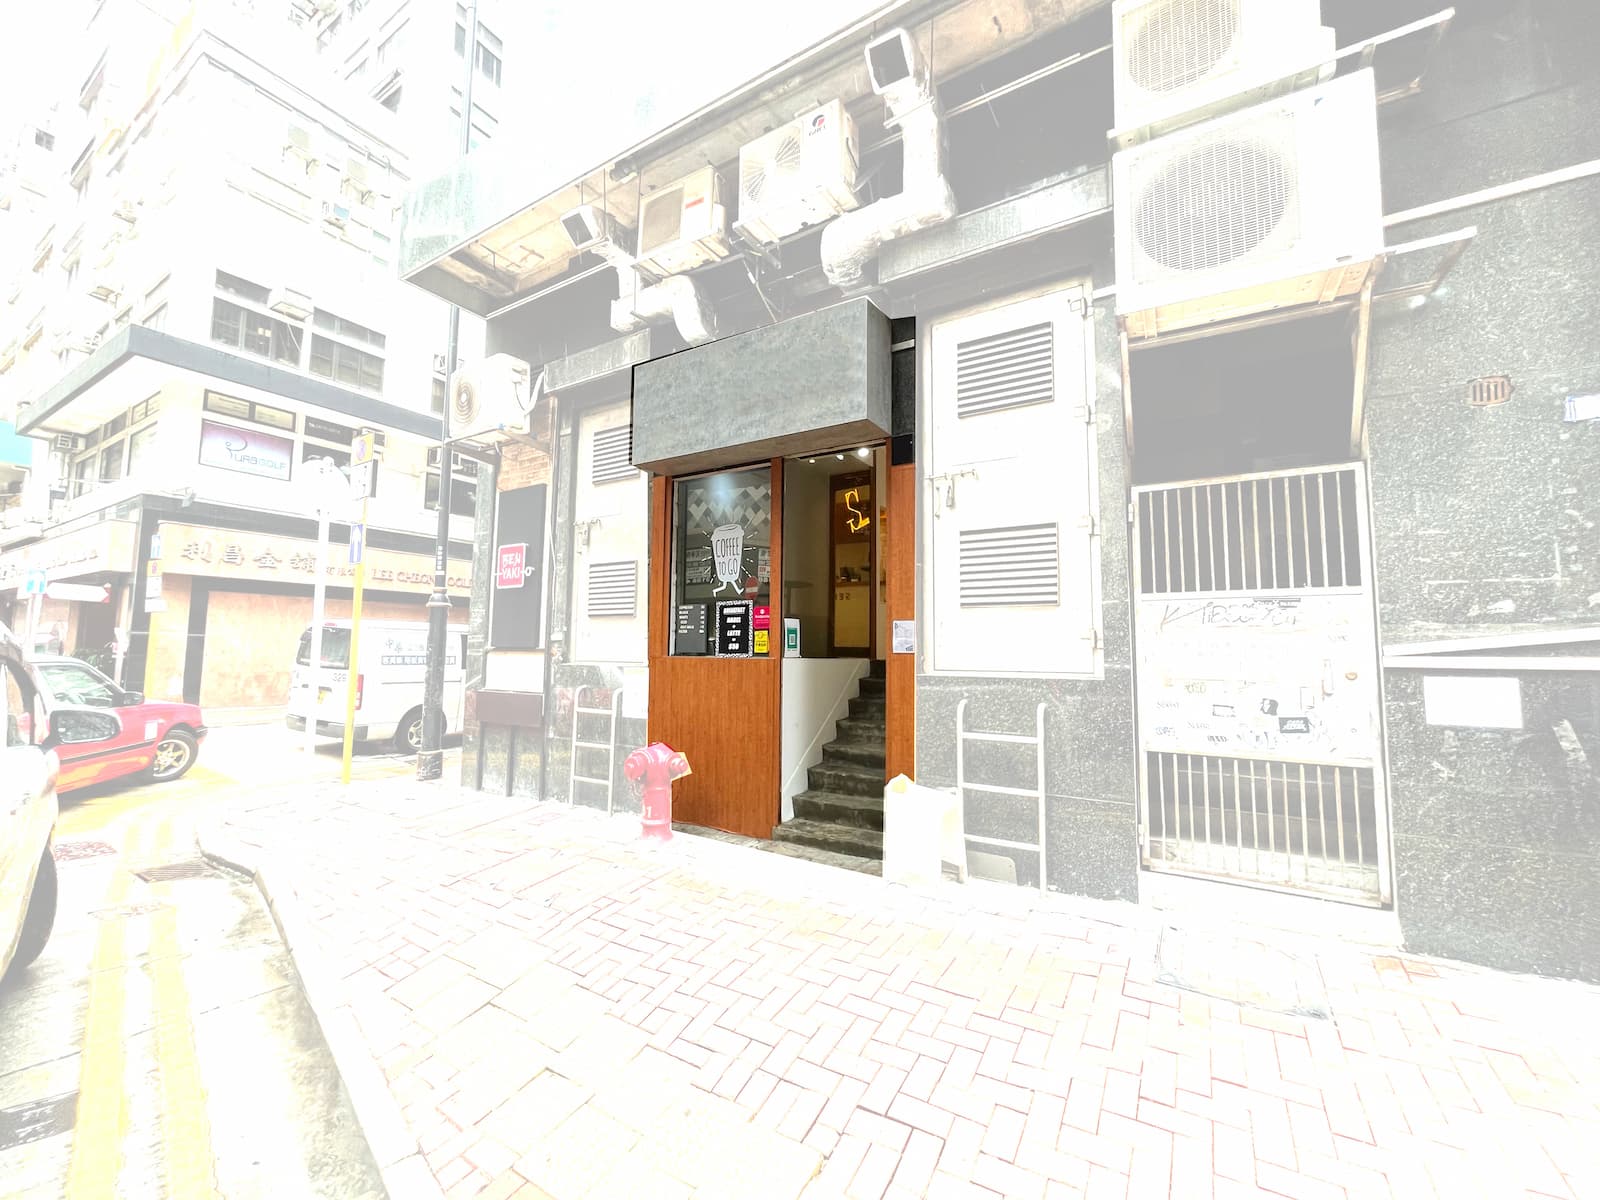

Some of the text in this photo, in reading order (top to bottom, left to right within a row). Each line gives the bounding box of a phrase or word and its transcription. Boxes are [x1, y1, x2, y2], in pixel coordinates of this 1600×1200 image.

[715, 537, 740, 558] COFFEE
[502, 567, 521, 579] YAKI
[718, 561, 727, 576] TO
[727, 558, 738, 576] GO
[396, 570, 435, 585] CHEON
